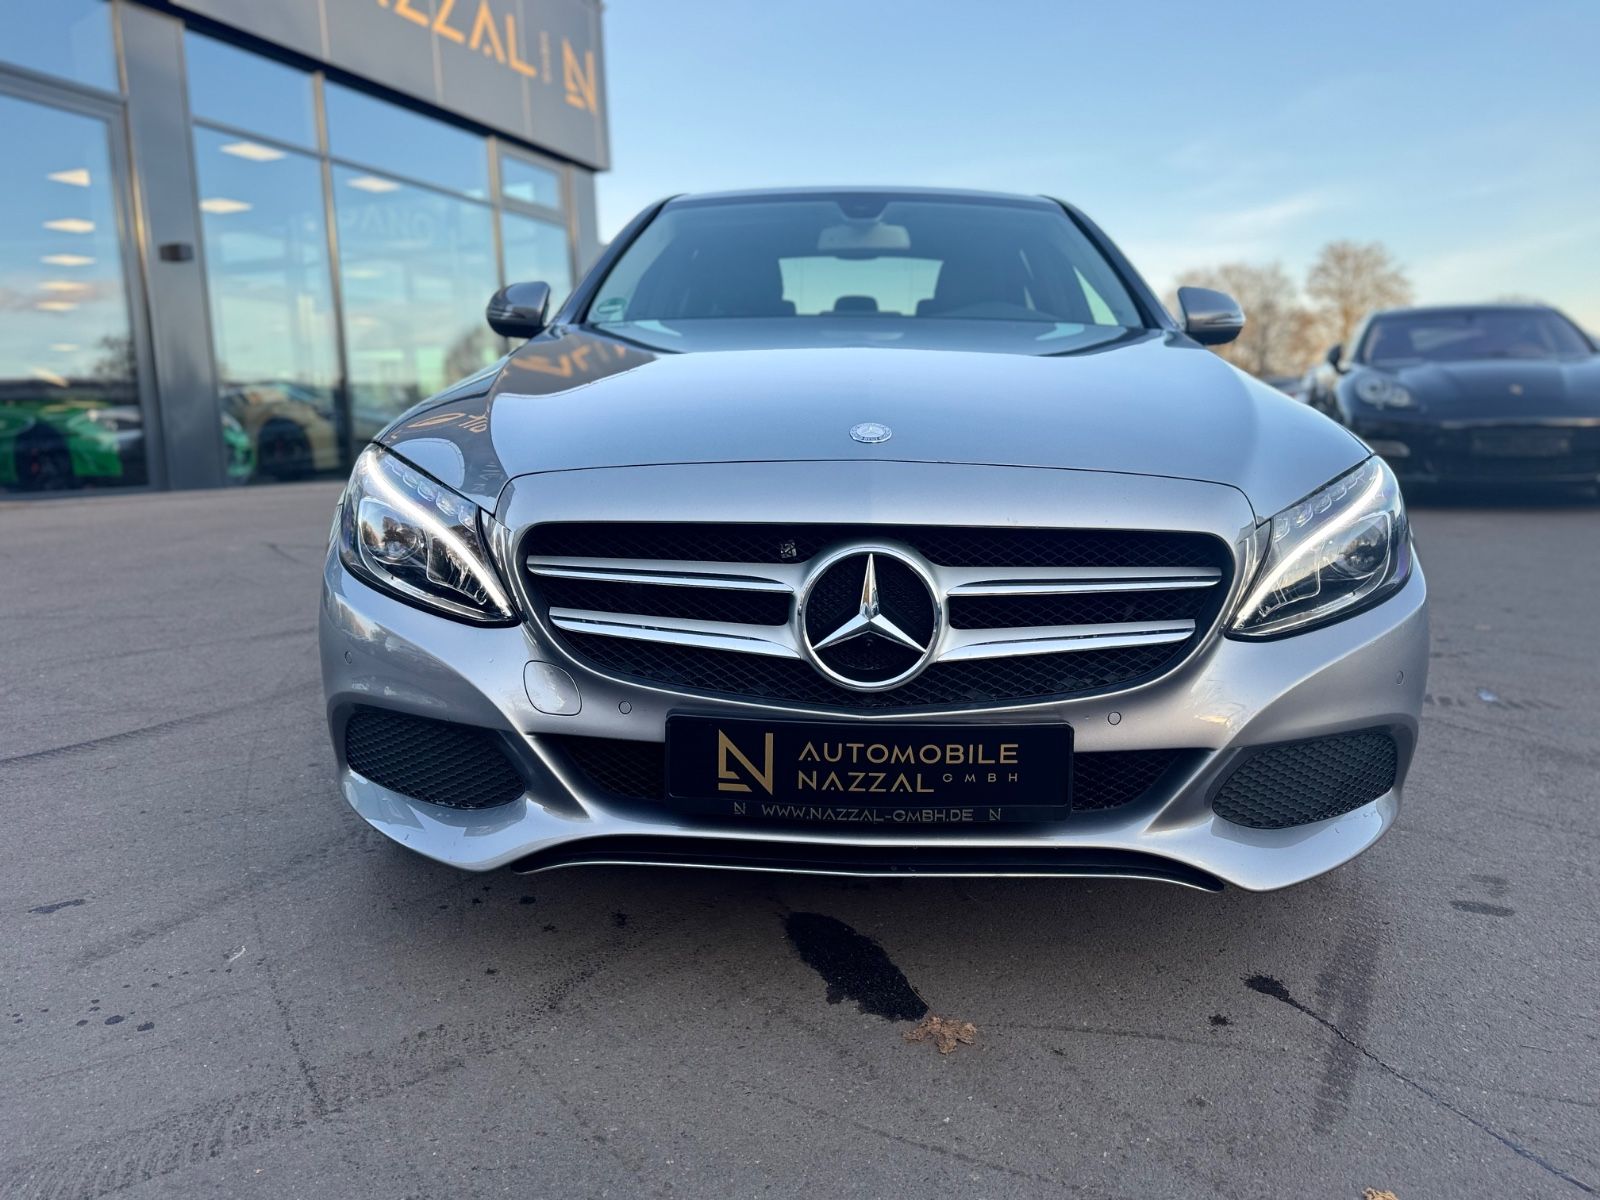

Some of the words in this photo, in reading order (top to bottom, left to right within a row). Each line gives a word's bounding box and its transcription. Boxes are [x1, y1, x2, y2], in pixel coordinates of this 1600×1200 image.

[798, 741, 1019, 764] AUTOMOBILE
[798, 770, 934, 793] NAZZAL
[942, 772, 1018, 783] GMBH
[761, 804, 974, 822] WWW.NAZZAL-GMBH.DE
